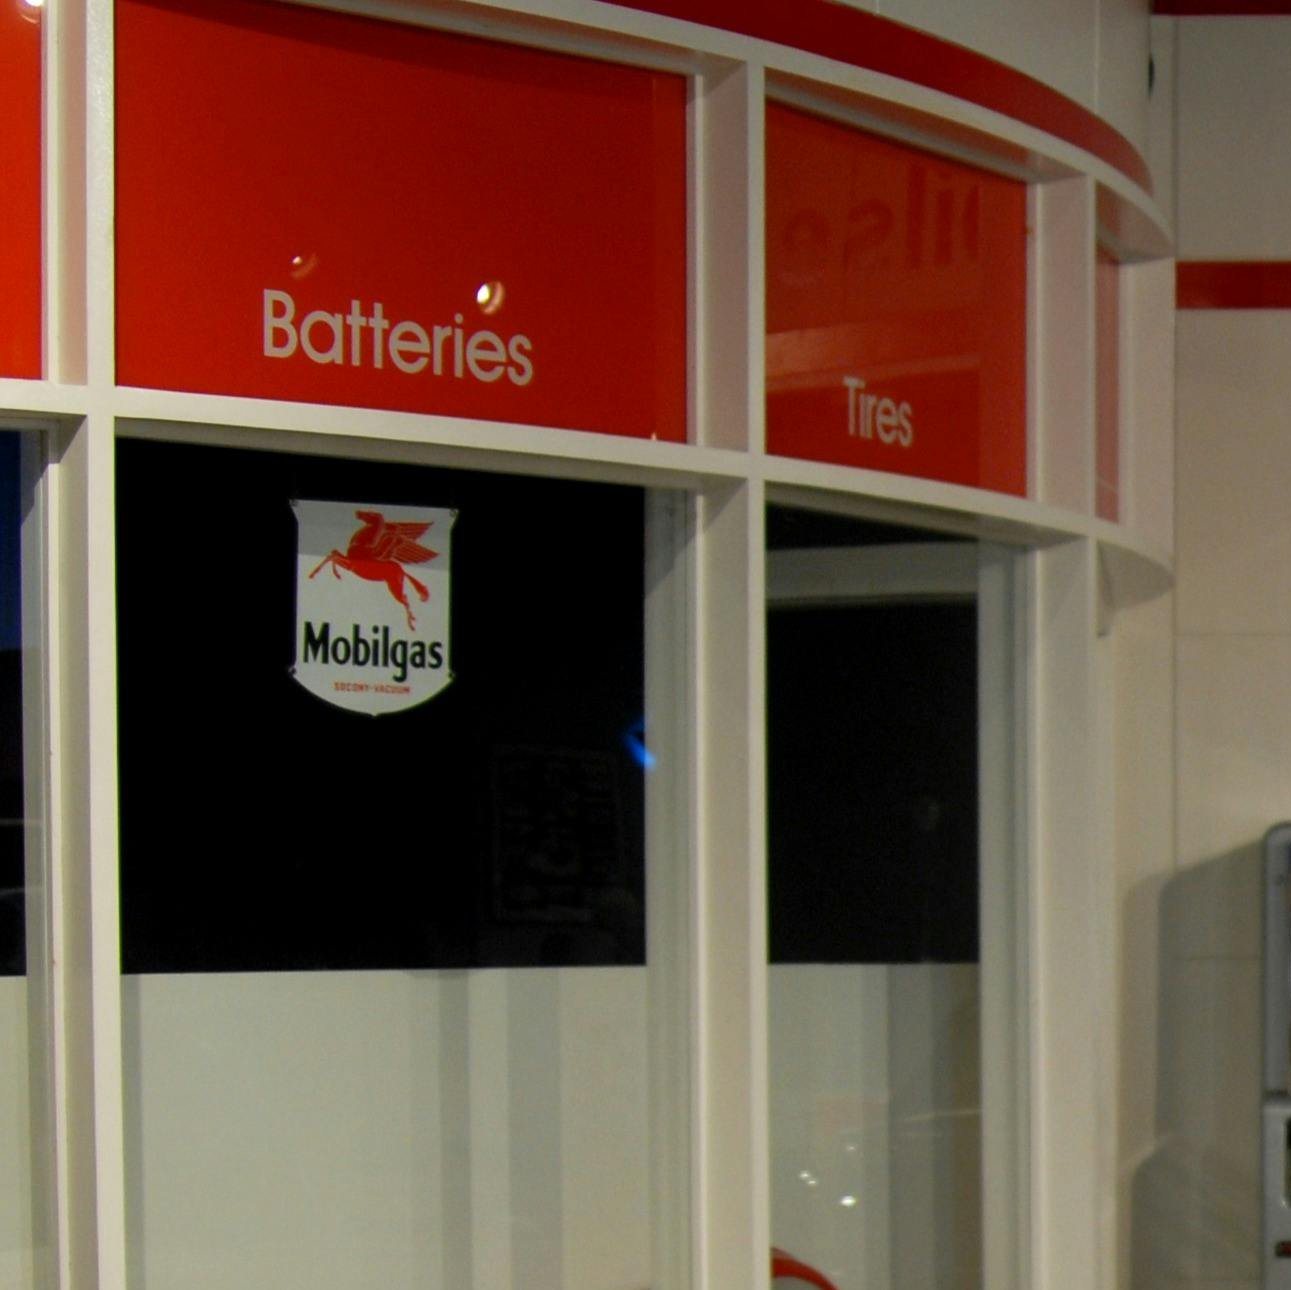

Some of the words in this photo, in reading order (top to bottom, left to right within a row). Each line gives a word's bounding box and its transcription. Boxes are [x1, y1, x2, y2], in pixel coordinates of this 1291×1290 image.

[263, 288, 533, 386] Batteries
[843, 375, 913, 447] Tires
[303, 621, 443, 682] Mobilgas
